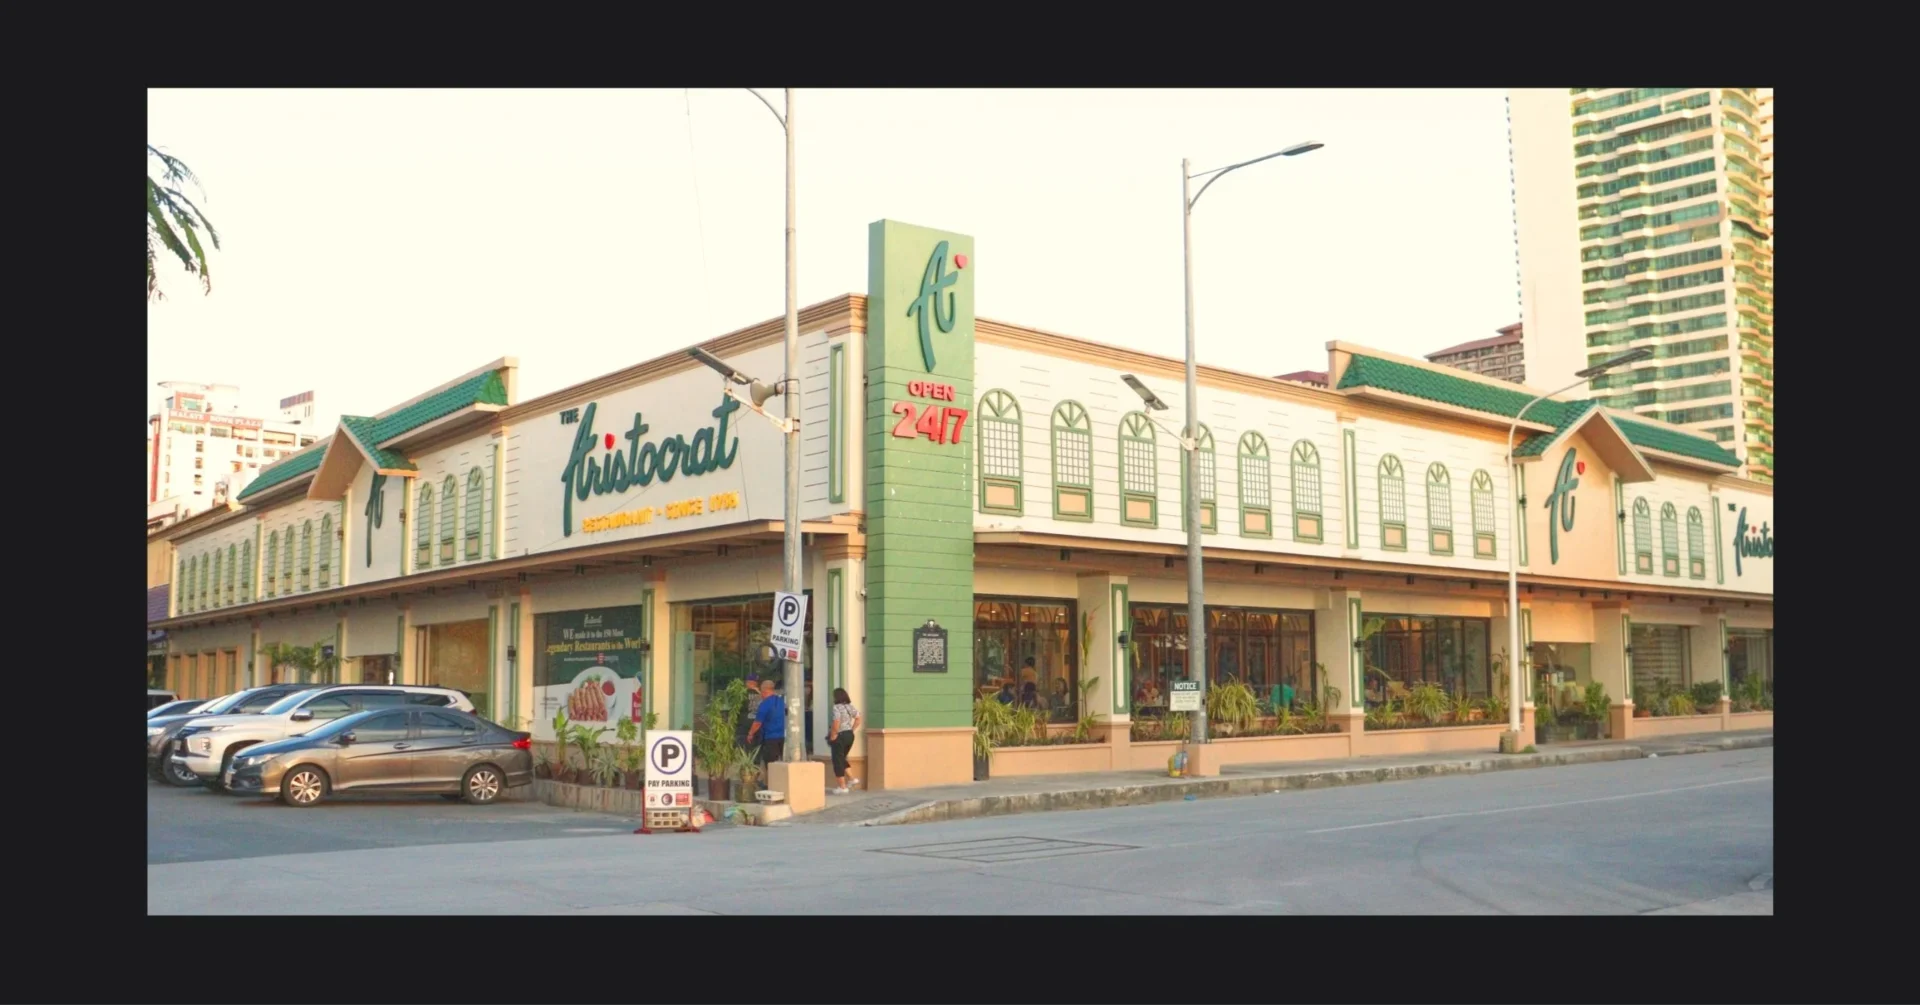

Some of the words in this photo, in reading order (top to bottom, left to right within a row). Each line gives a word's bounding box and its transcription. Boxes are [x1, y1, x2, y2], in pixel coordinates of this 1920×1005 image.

[908, 380, 956, 402] OPEN
[560, 408, 580, 425] THE
[892, 400, 969, 445] 24/7
[561, 391, 740, 537] Aristocrat
[783, 601, 796, 621] P
[772, 634, 799, 646] PARKING
[780, 628, 791, 636] PAY
[1174, 682, 1197, 690] NOTICE
[661, 744, 680, 768] P
[648, 780, 660, 788] PAY
[661, 780, 690, 788] PARKING
